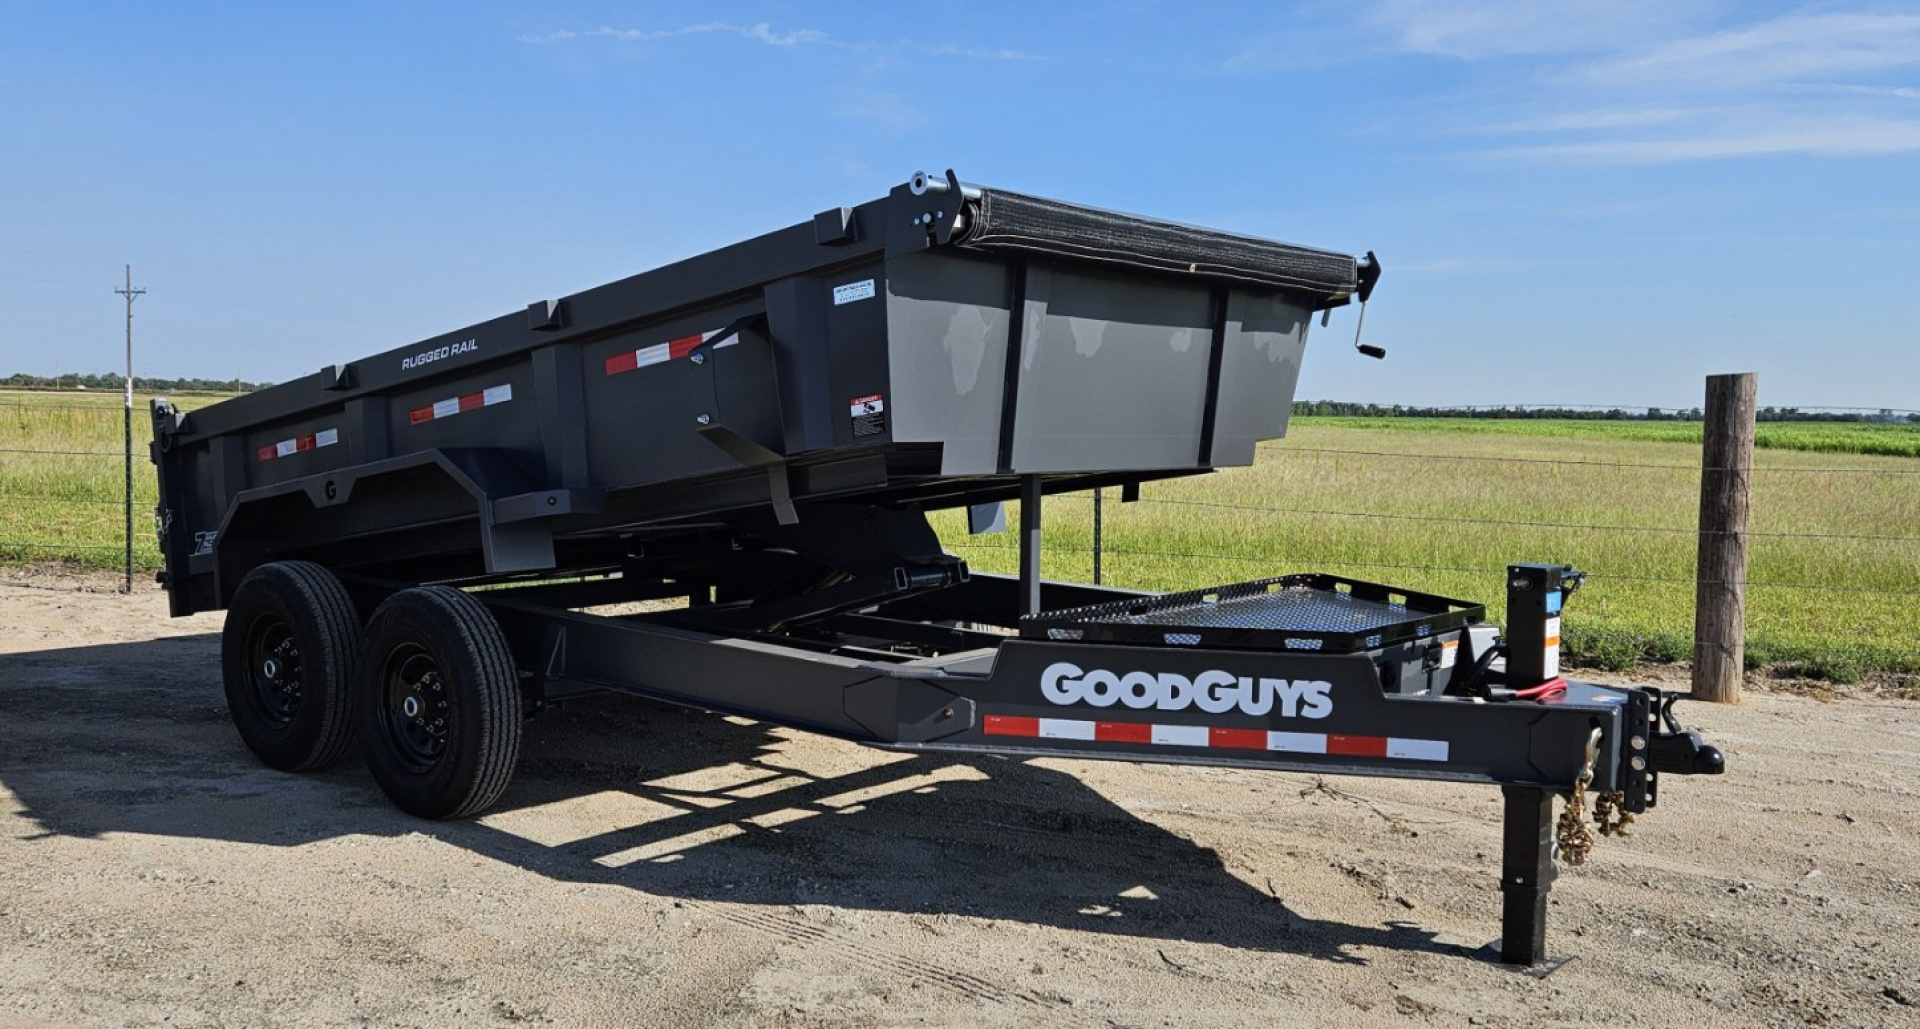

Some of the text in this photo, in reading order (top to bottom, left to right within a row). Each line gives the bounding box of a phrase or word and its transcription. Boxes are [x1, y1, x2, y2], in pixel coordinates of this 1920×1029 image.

[401, 338, 478, 371] RUGGED RAIL
[1040, 662, 1333, 719] GOODGUYS
